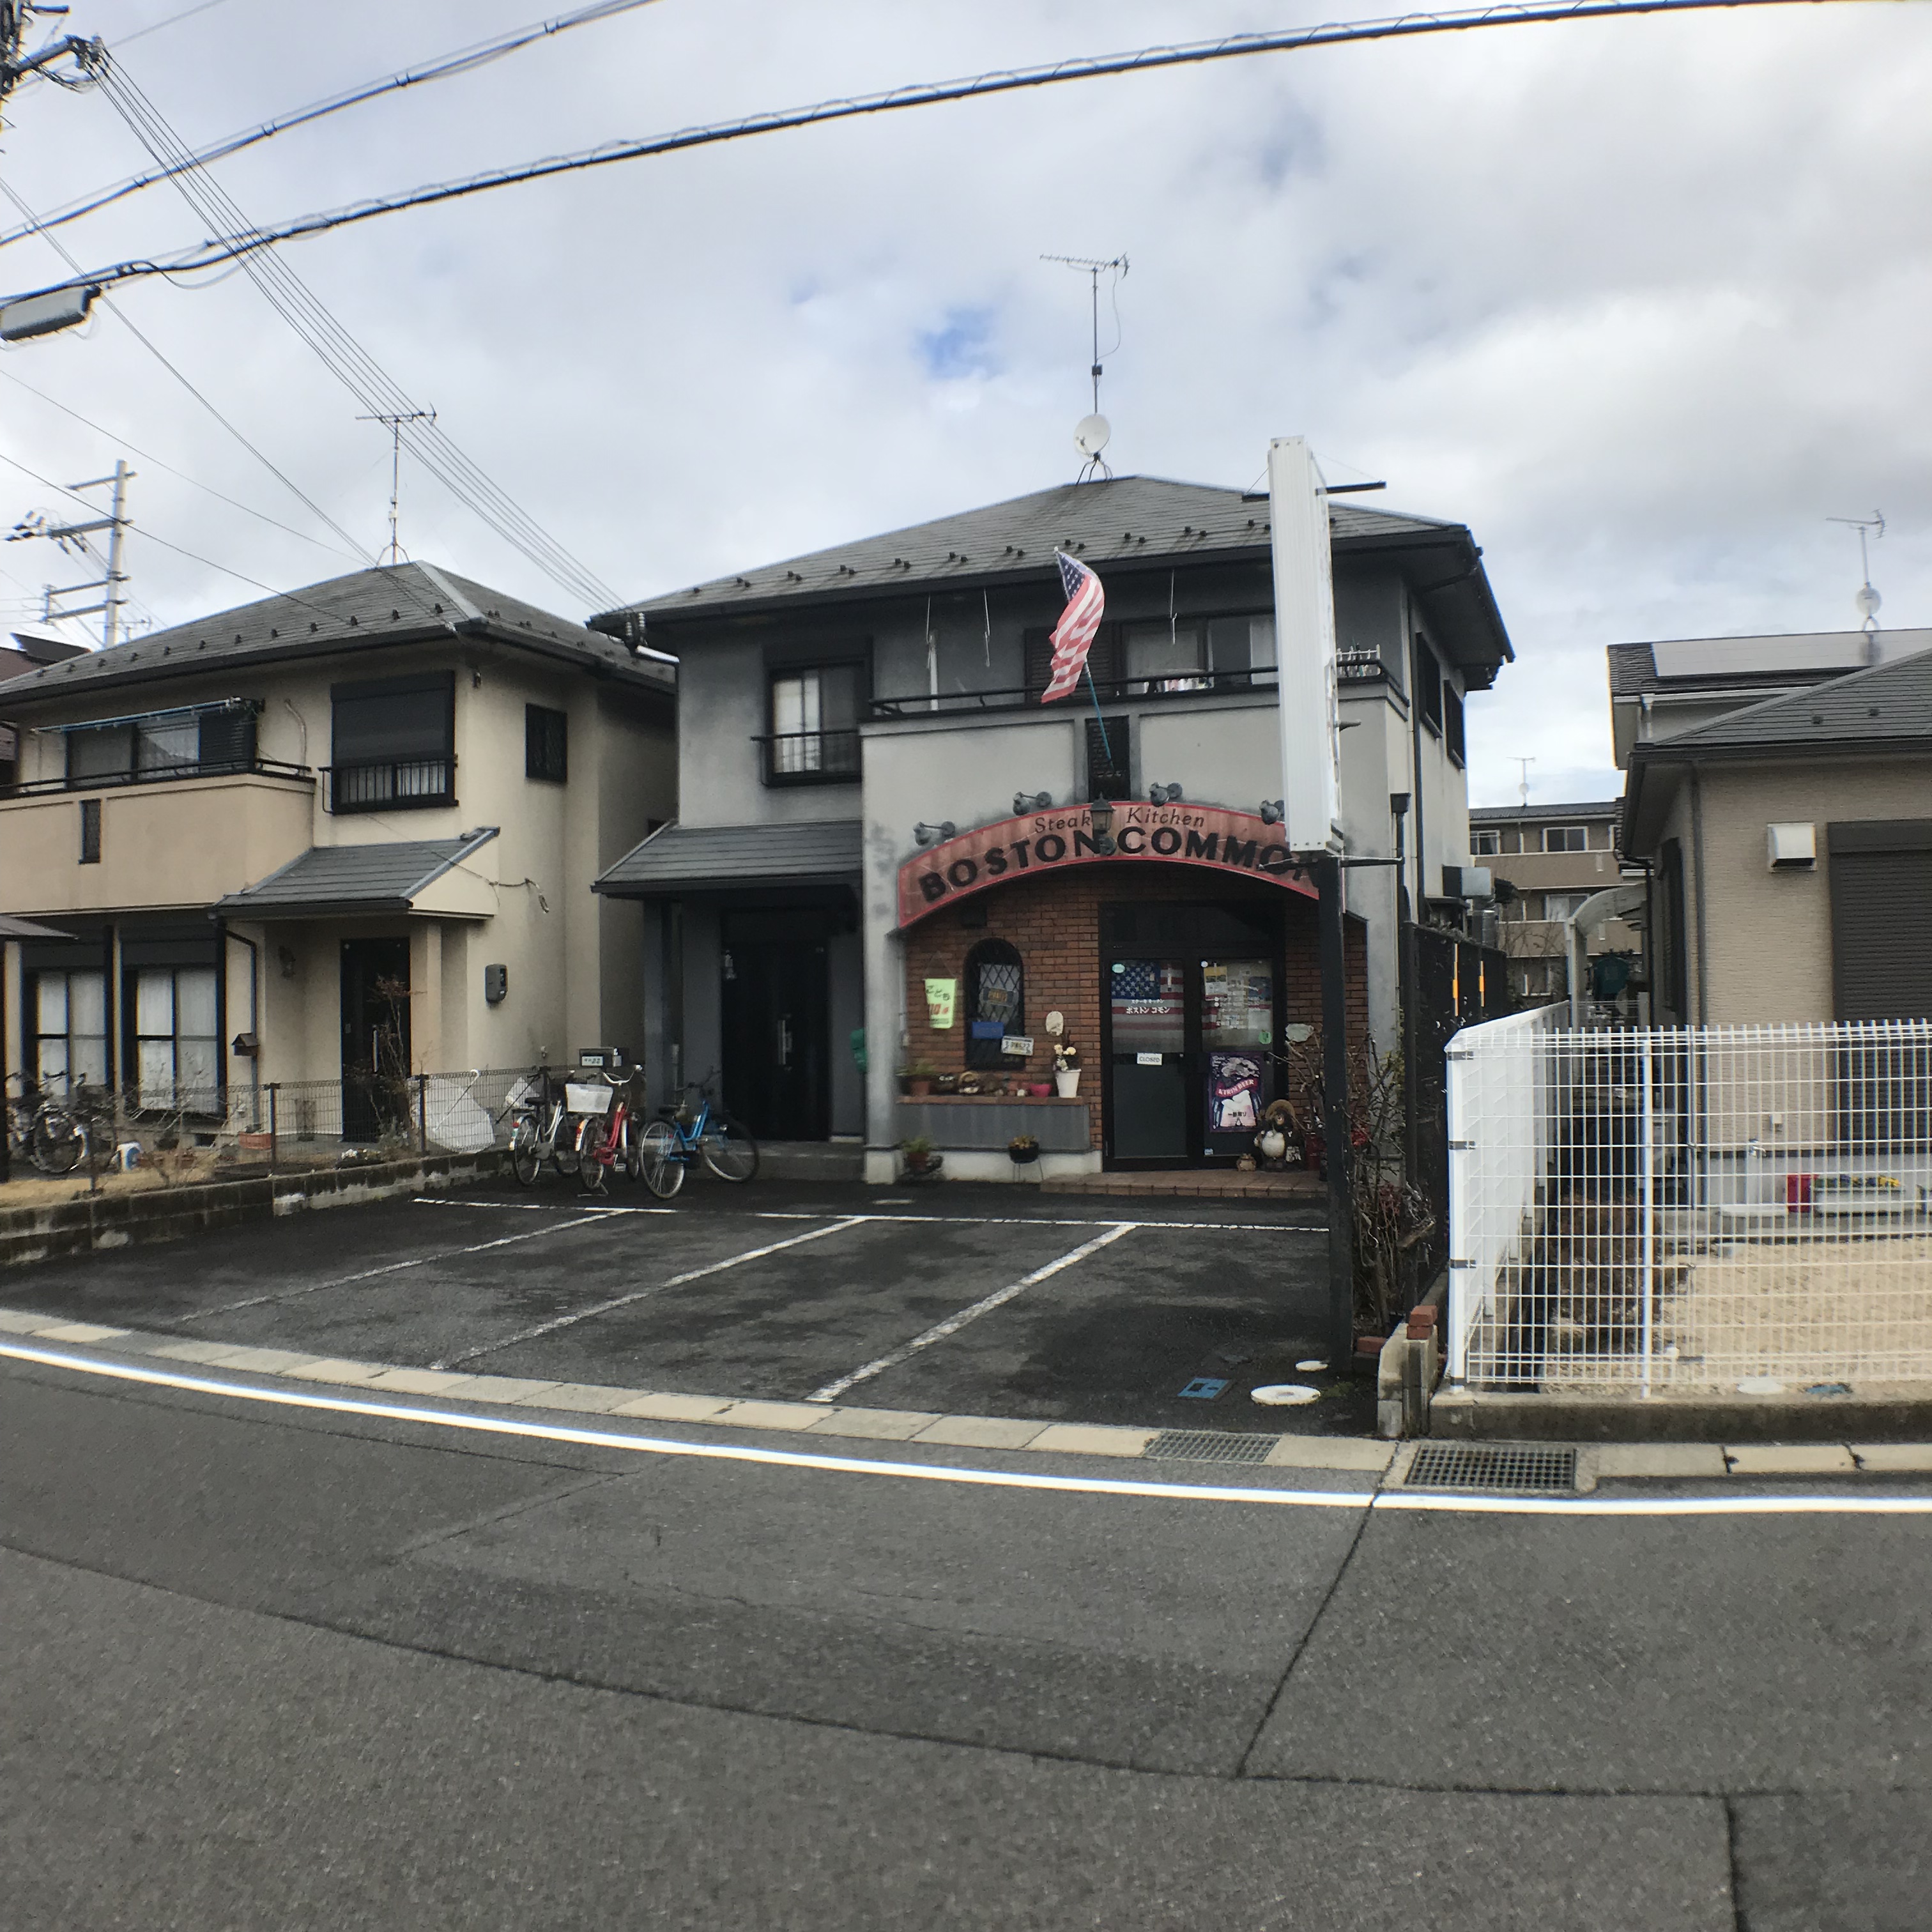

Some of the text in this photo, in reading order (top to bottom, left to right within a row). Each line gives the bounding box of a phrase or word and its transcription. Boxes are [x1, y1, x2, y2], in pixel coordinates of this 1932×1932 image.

[1034, 807, 1204, 833] Steak Kitchen
[918, 830, 1101, 902] BOSTON
[1238, 1079, 1254, 1089] BEER
